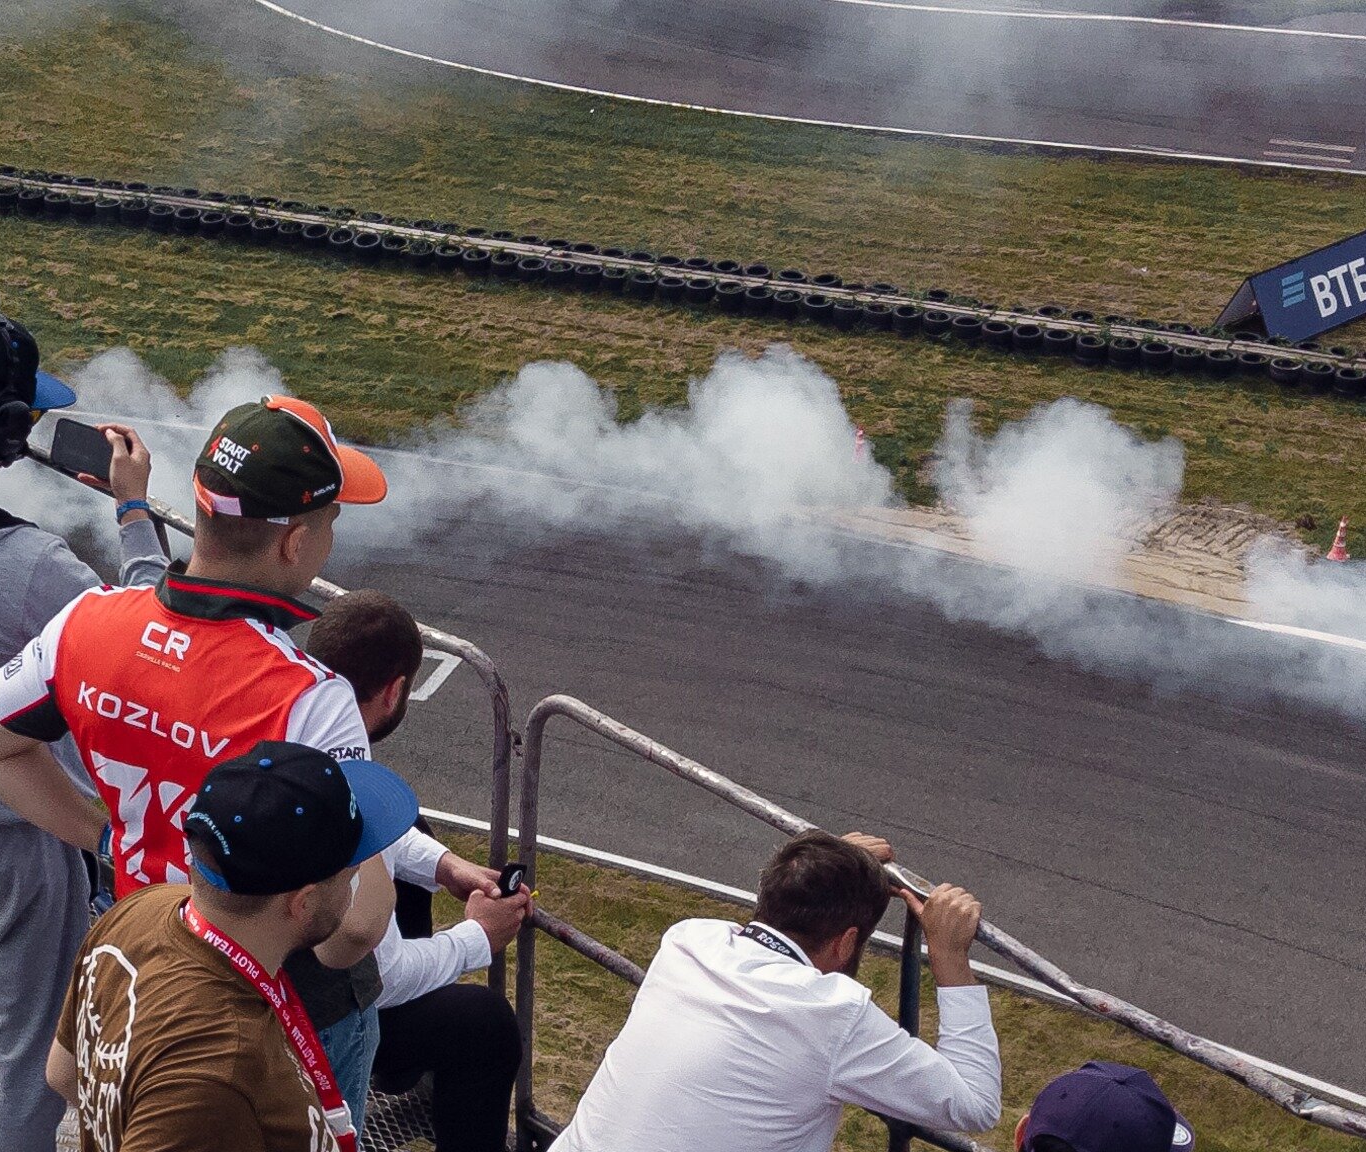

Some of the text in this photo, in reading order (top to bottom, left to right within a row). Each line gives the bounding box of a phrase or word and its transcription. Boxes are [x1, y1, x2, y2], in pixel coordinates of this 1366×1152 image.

[211, 448, 243, 474] VOLT
[218, 436, 251, 462] START
[140, 620, 191, 661] CR
[77, 680, 231, 758] KOZLOV
[327, 746, 366, 761] START
[203, 929, 260, 980] PILOT TEAM
